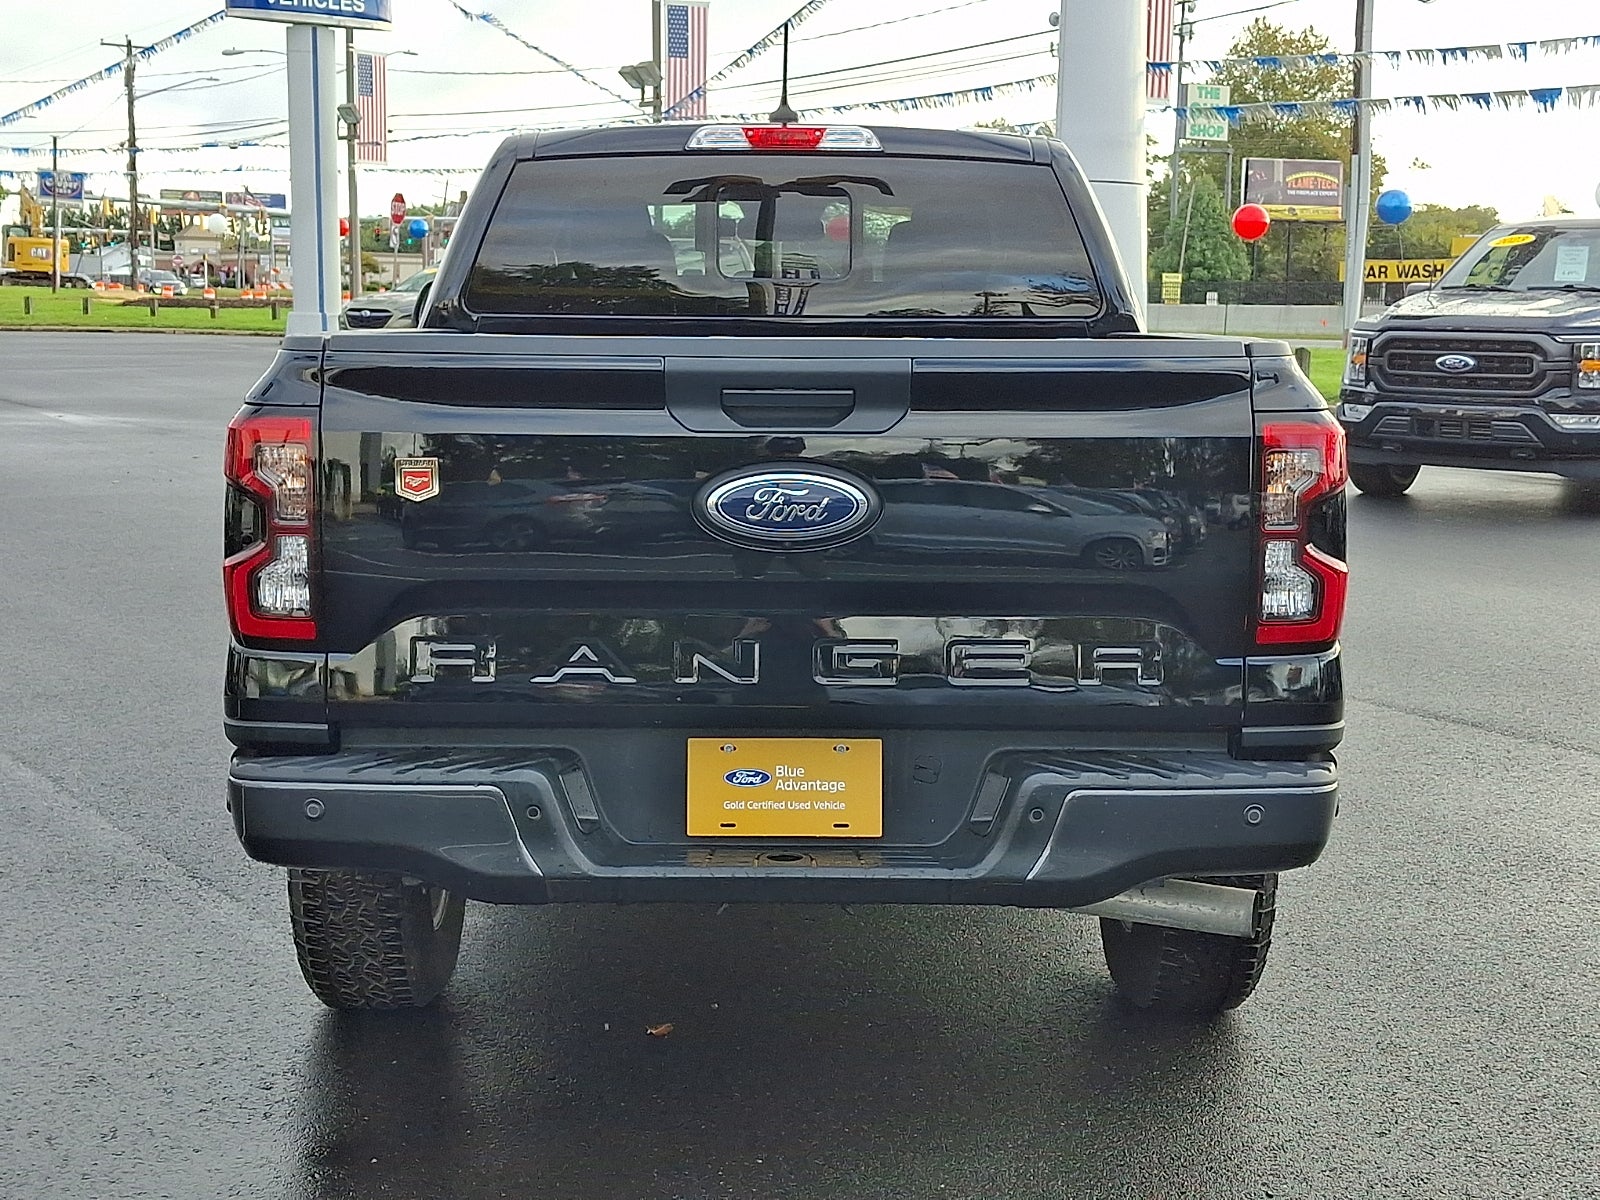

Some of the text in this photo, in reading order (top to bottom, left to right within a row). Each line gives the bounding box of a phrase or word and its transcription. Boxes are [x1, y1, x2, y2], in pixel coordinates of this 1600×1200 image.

[267, 0, 365, 13] CLES
[1197, 86, 1221, 100] THE
[1189, 124, 1224, 138] SHOP
[391, 202, 405, 216] STOP
[31, 247, 47, 259] CAT
[1363, 263, 1444, 279] AR WASH
[745, 487, 830, 522] Ford
[409, 636, 1165, 686] RANGER
[732, 770, 763, 785] Ford
[775, 765, 805, 777] Blue
[775, 779, 846, 793] Advantage
[723, 801, 846, 810] Gold Certified Used Vehicle
